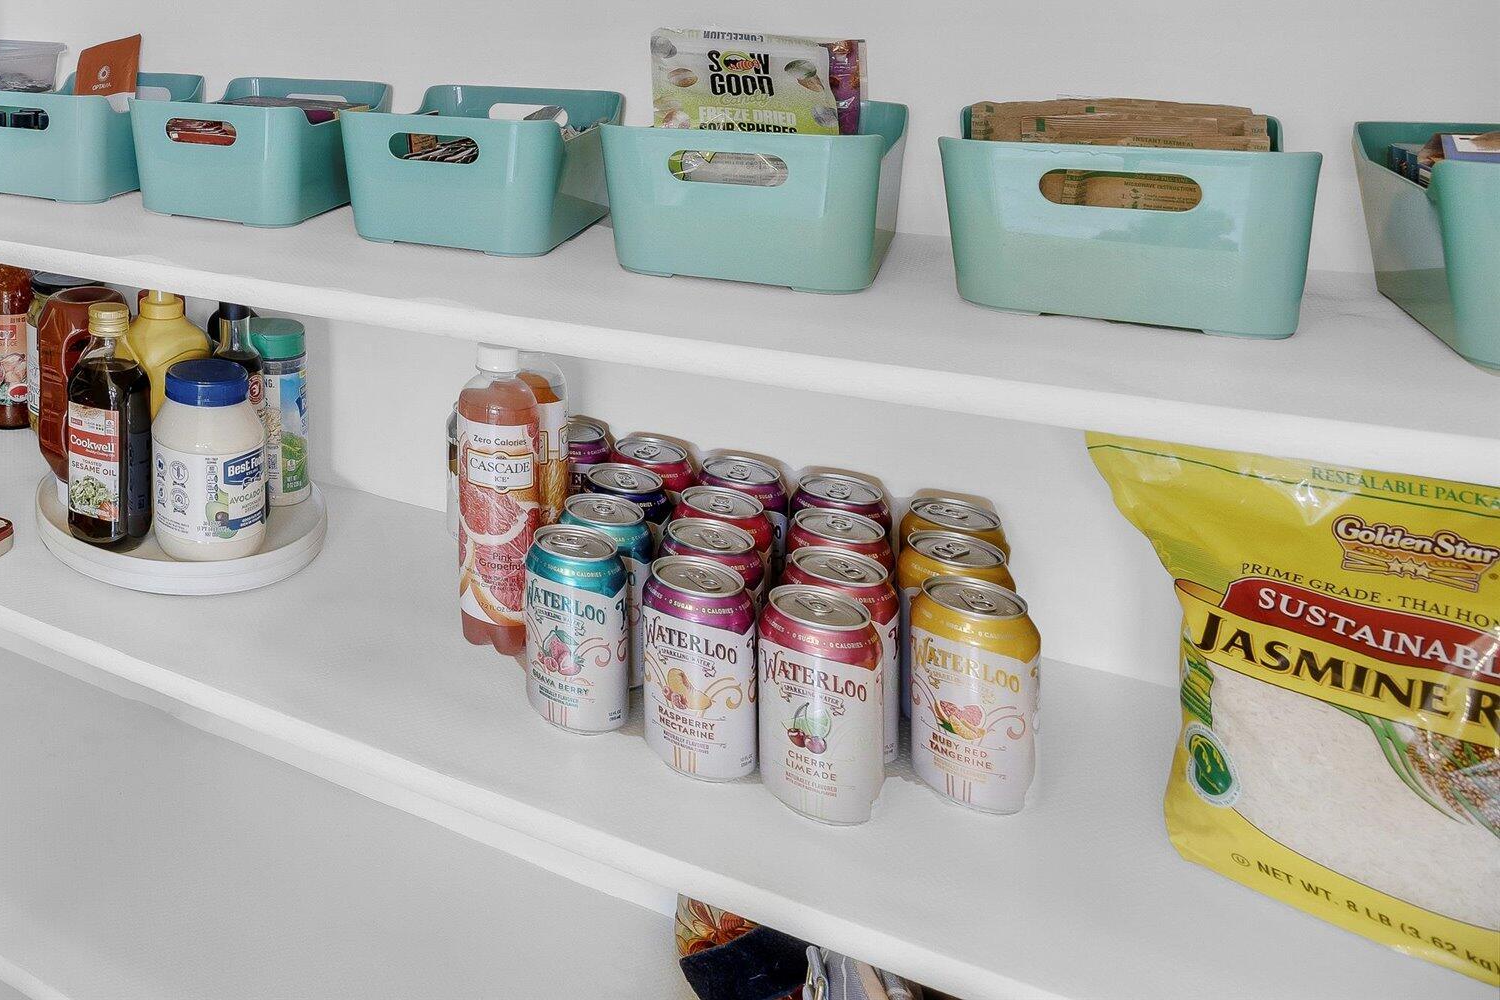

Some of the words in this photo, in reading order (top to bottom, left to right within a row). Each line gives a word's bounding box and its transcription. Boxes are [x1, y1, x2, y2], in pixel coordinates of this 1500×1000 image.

[70, 435, 115, 453] Cookwell
[473, 434, 491, 445] Zero
[494, 437, 527, 448] Calories
[71, 460, 100, 475] SESAME
[102, 468, 117, 477] OIL
[227, 462, 250, 478] Best
[470, 458, 531, 474] CASCADE
[1312, 466, 1428, 498] RESEALABLE
[1336, 517, 1432, 554] Golden
[1434, 532, 1499, 565] Star
[493, 552, 513, 563] Pink
[1241, 562, 1304, 585] PRIME
[1309, 578, 1381, 604] GRADE
[1398, 595, 1450, 617] THAI
[526, 578, 606, 625] WATERLOO
[707, 607, 734, 615] CALORIES
[643, 614, 738, 665] WATERLOO
[1258, 587, 1500, 680] SUSTAINABL
[760, 648, 867, 702] WATERLOO
[1199, 611, 1451, 718] JASMINE
[558, 681, 590, 696] BERRY
[658, 705, 716, 731] RASPBERRY
[658, 717, 715, 740] NECTARINE
[929, 739, 993, 770] TANGERINE
[931, 732, 959, 750] RUBY
[964, 746, 988, 759] RED
[785, 758, 837, 781] LIMEADE
[787, 750, 833, 770] CHERRY
[1346, 900, 1358, 914] 8
